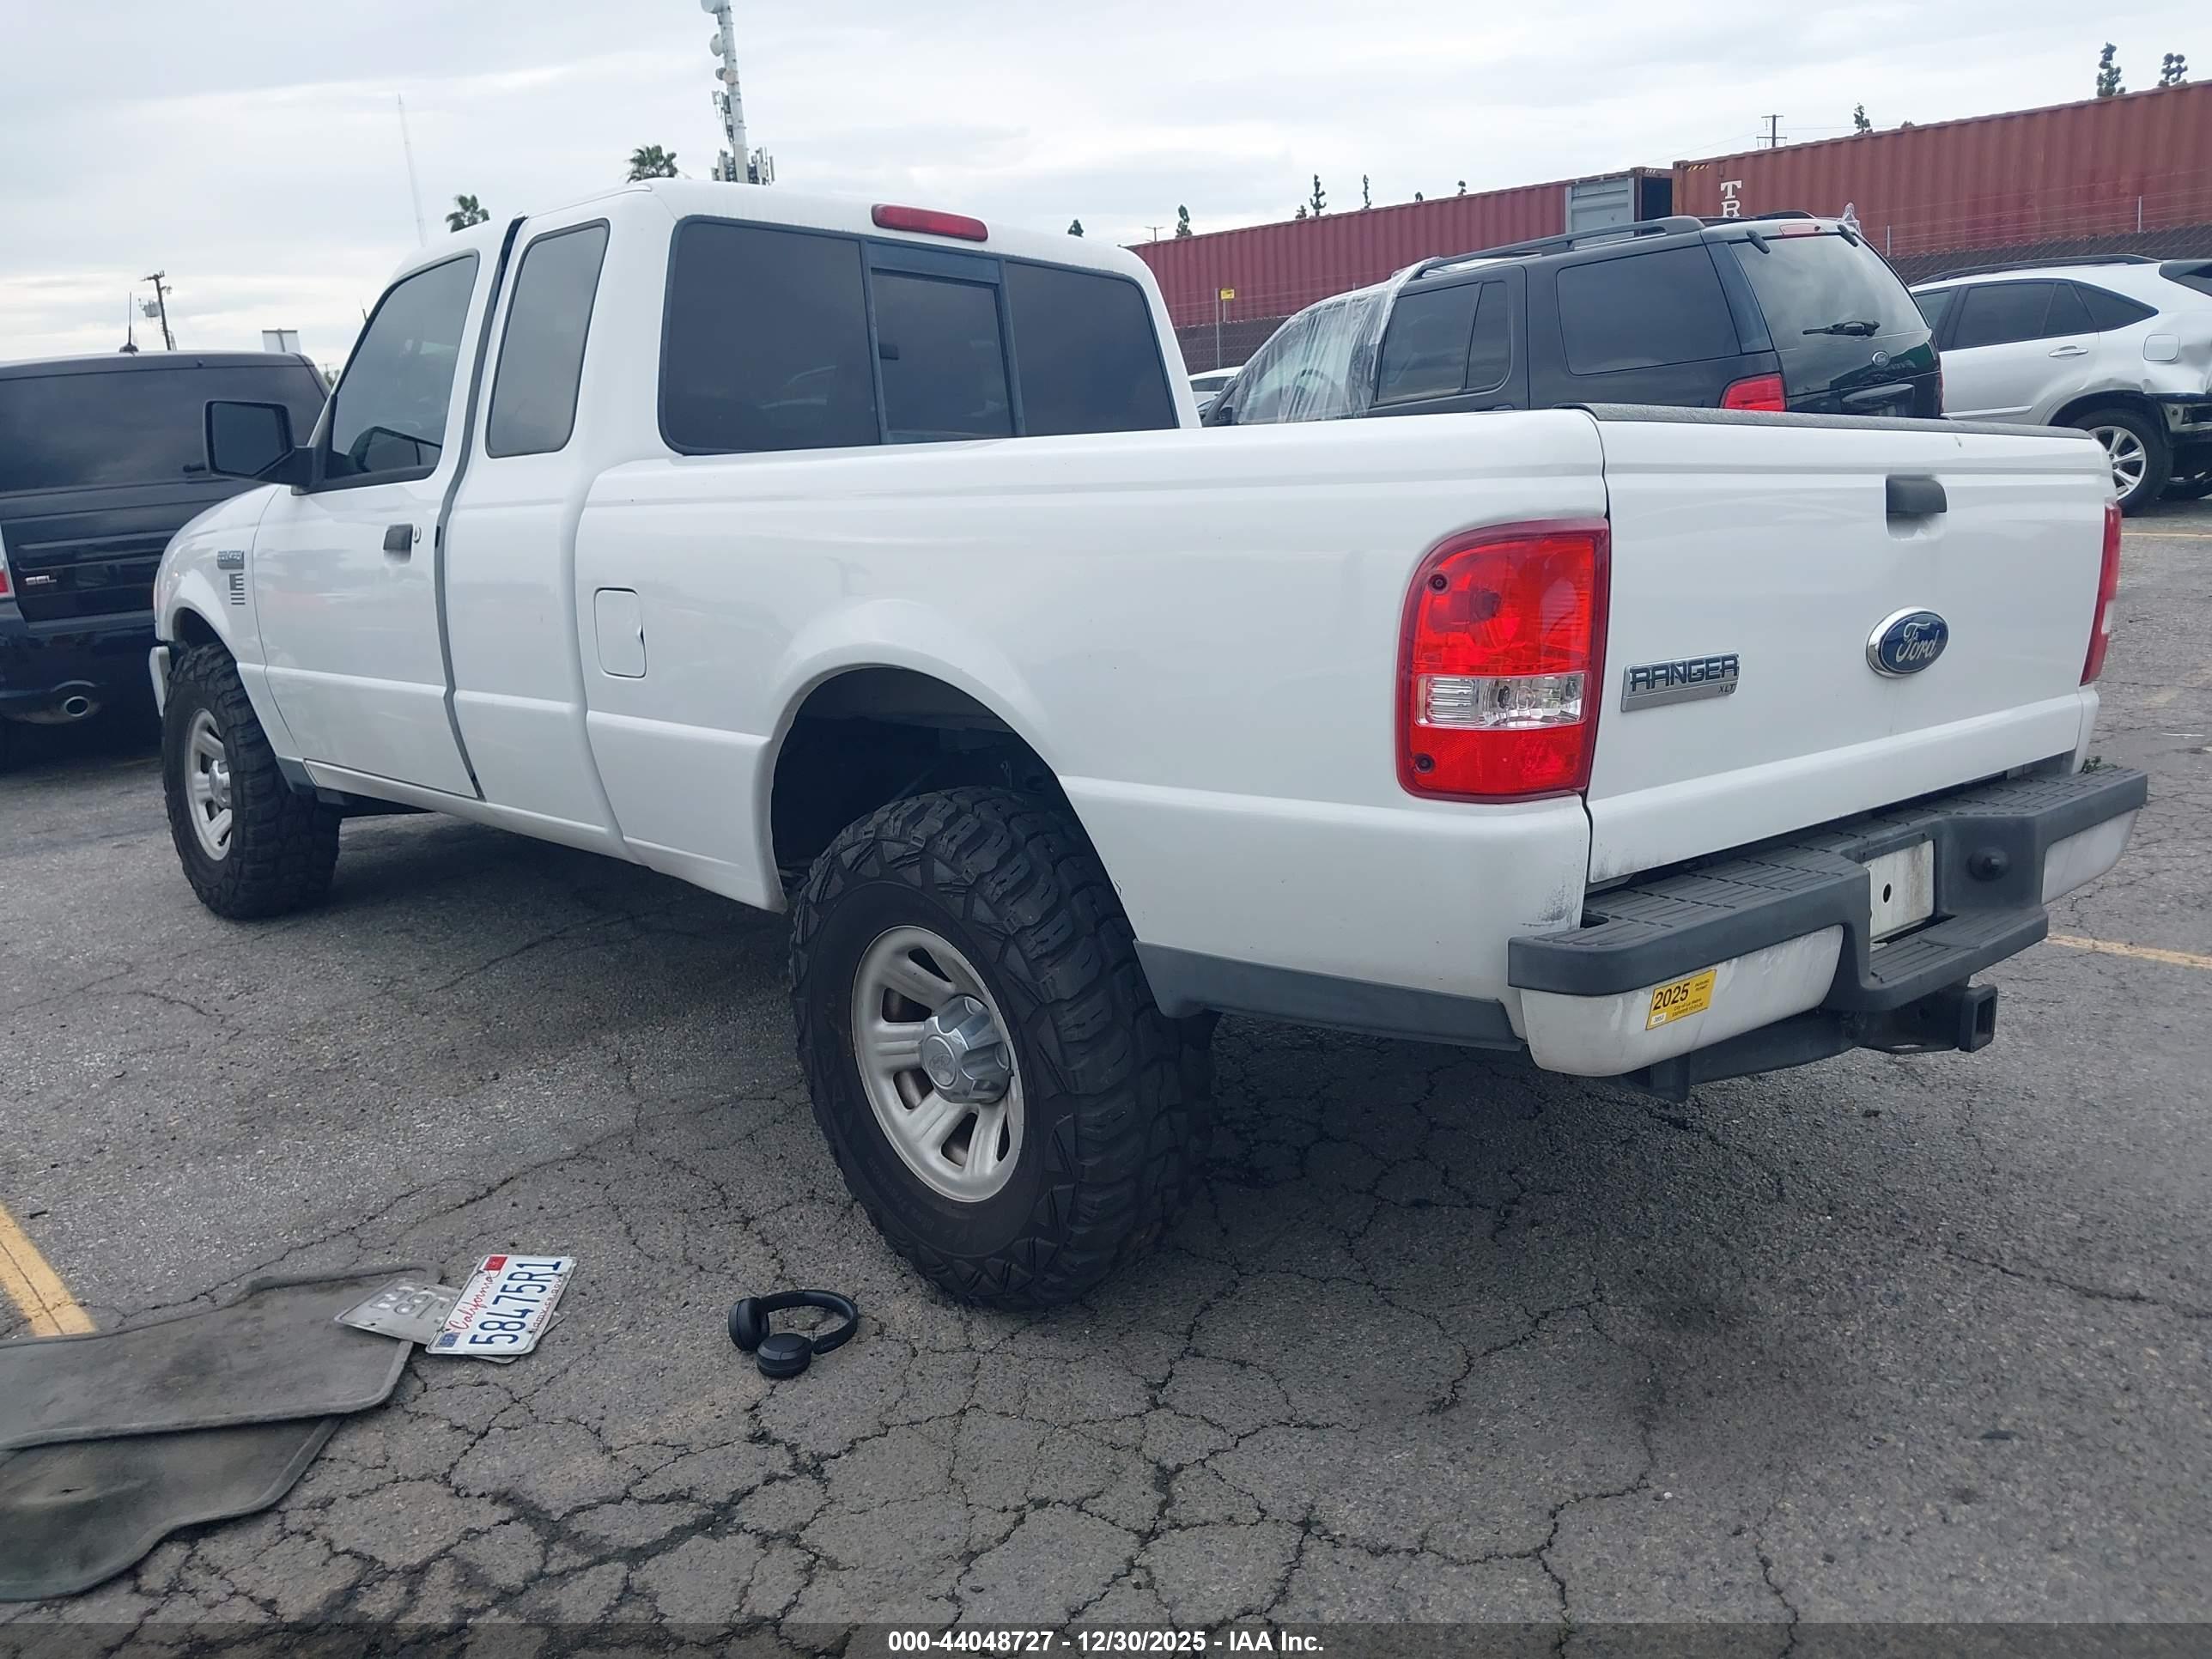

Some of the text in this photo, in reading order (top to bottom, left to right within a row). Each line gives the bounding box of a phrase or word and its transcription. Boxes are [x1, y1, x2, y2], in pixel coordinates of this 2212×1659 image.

[1896, 622, 1940, 662] Ford
[1630, 654, 1739, 692] RANGER
[1718, 684, 1736, 694] XLT
[1653, 982, 1690, 1011] 2025
[448, 1272, 497, 1331] California
[469, 1261, 562, 1345] 58475R1
